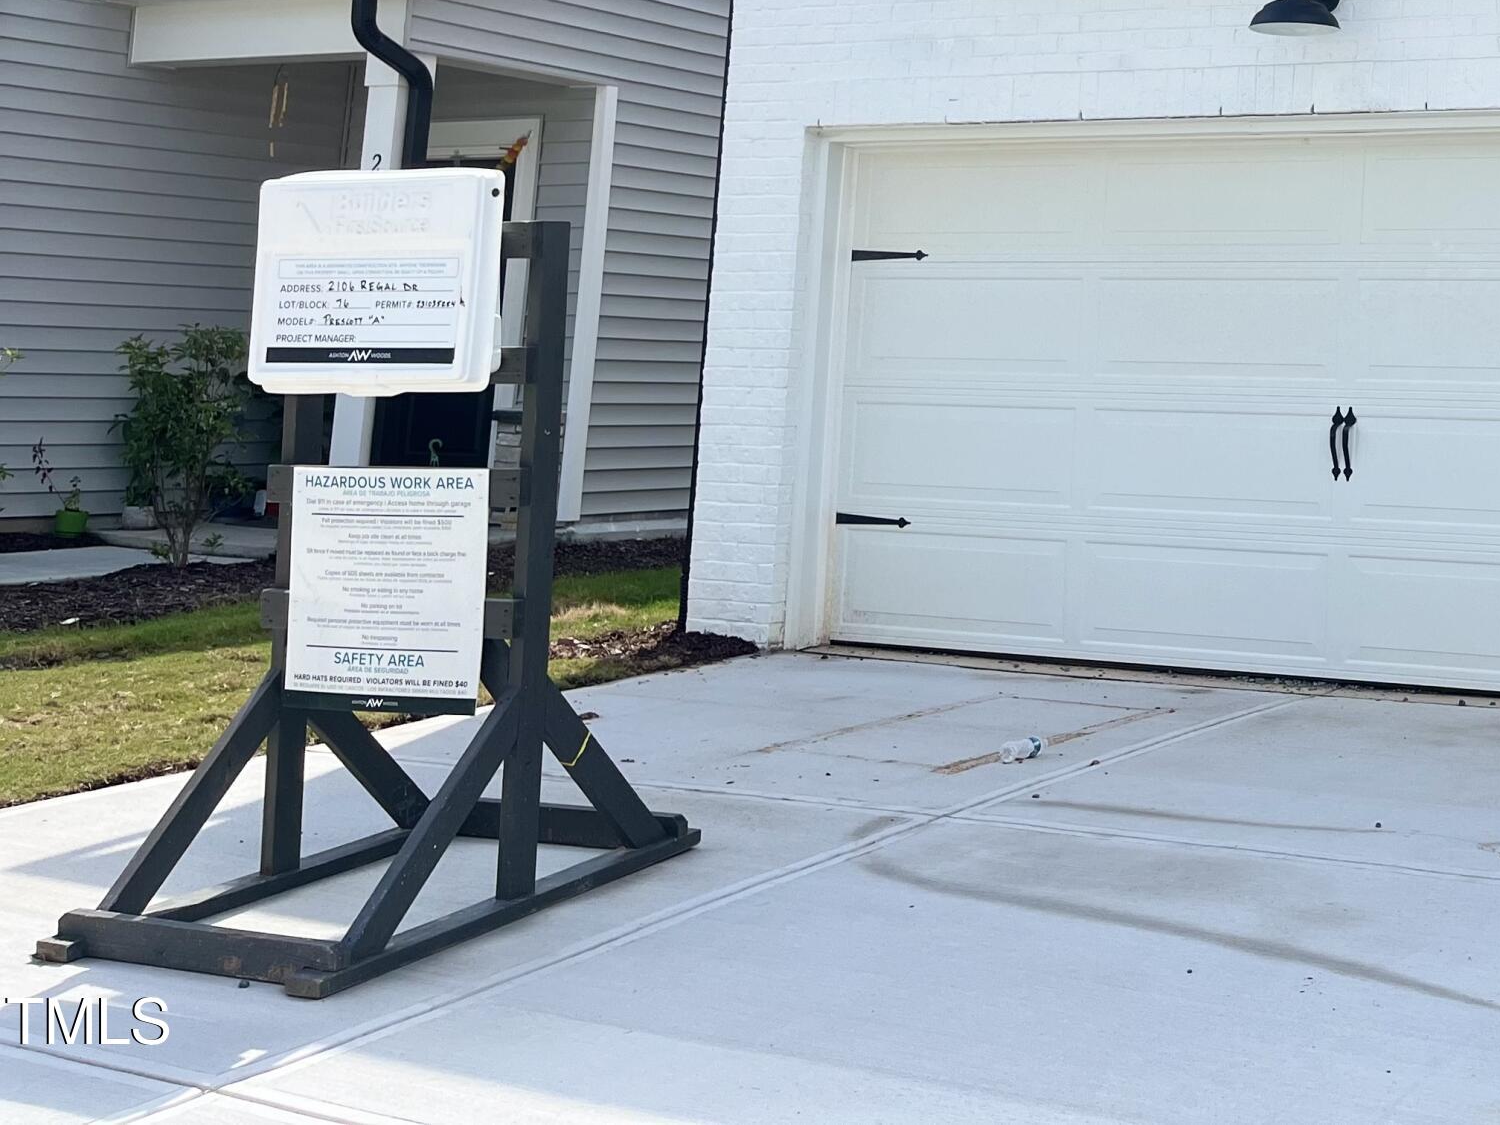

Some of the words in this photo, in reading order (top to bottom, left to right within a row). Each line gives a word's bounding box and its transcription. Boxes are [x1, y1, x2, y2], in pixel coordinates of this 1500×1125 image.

[280, 284, 323, 292] ADDRESS:
[328, 281, 354, 292] 2106
[360, 280, 396, 291] REGAL
[403, 283, 418, 291] DR
[276, 334, 312, 342] PROJECT
[306, 475, 386, 489] HAZARDOUS
[390, 477, 431, 489] WORK
[436, 477, 475, 490] AREA
[334, 652, 384, 665] SAFETY
[387, 654, 424, 667] AREA
[294, 673, 311, 681] HARD
[329, 676, 362, 684] REQUIRED
[455, 680, 468, 688] $40
